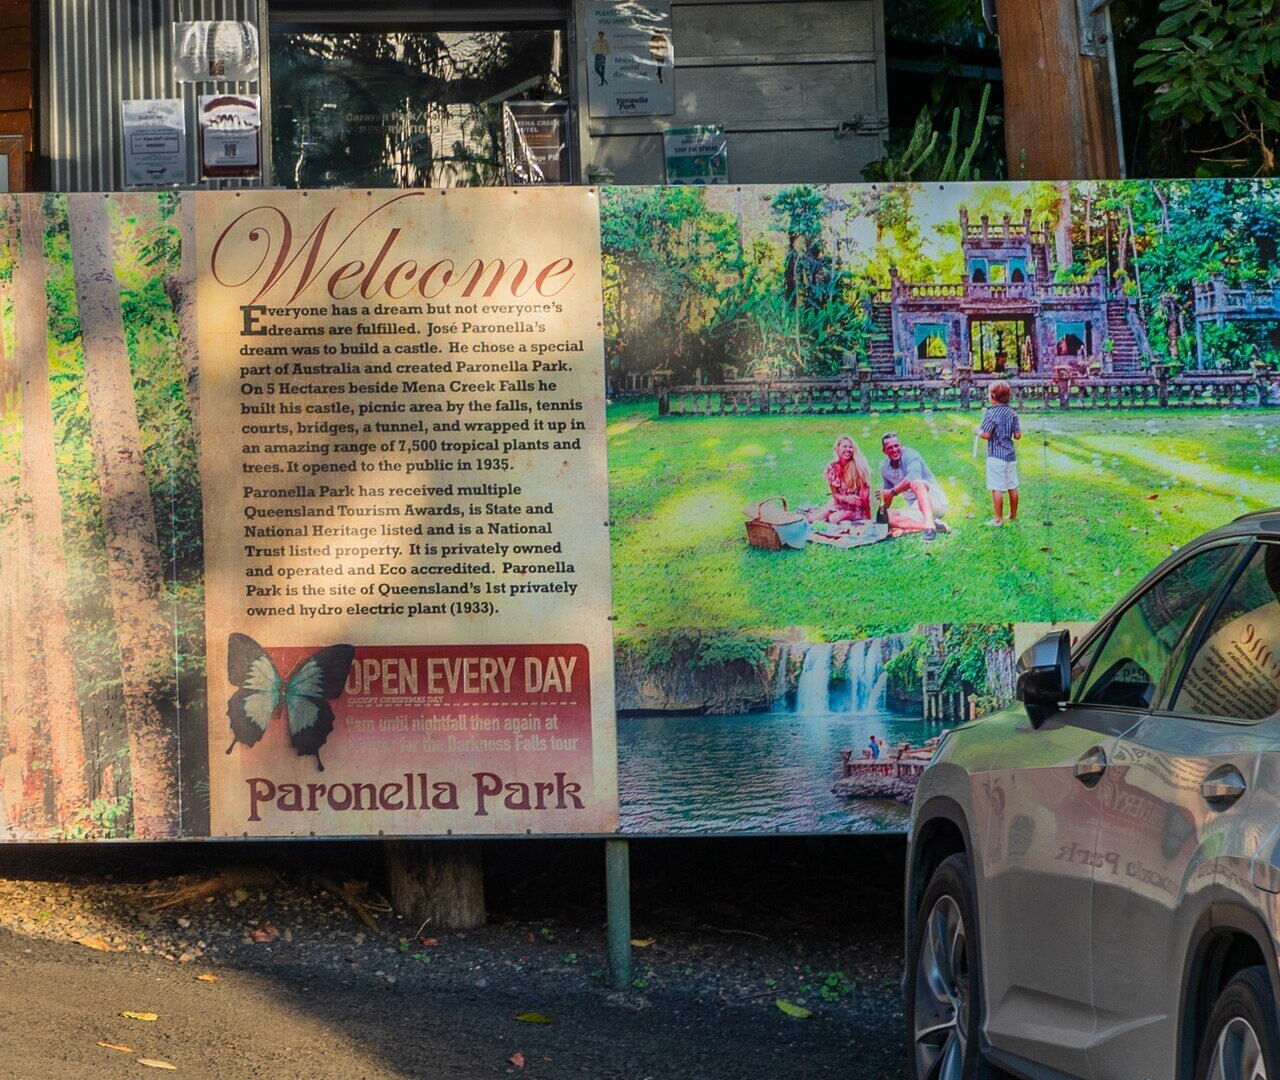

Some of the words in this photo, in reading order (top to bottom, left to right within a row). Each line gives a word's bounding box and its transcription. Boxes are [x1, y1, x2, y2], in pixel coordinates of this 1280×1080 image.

[345, 112, 389, 122] Caravn
[211, 191, 576, 307] Welcome
[240, 302, 328, 336] Everyone
[331, 304, 358, 316] has
[362, 307, 370, 315] a
[374, 303, 423, 315] dream
[426, 303, 450, 314] but
[455, 304, 477, 313] not
[482, 302, 562, 316] everyone's
[266, 324, 325, 336] dreams
[329, 327, 352, 335] are
[356, 323, 420, 335] fulfilled.
[427, 322, 458, 335] José
[462, 322, 545, 333] Paronella's
[240, 344, 288, 356] dream
[291, 346, 320, 355] was
[323, 344, 337, 355] to
[340, 342, 379, 354] build
[382, 345, 392, 354] a
[395, 342, 442, 354] castle.
[448, 342, 468, 353] He
[473, 341, 514, 352] chose
[531, 340, 584, 355] special
[240, 365, 271, 378] part
[274, 363, 290, 375] of
[292, 362, 361, 375] Australia
[364, 362, 392, 374] and
[396, 362, 452, 373] created
[456, 361, 528, 372] Paronella
[532, 360, 572, 372] Park.
[241, 383, 264, 395] On
[267, 383, 275, 394] 5
[278, 382, 345, 394] Hectares
[348, 381, 398, 393] beside
[402, 381, 446, 393] Mena
[450, 380, 495, 392] Creek
[499, 380, 534, 392] Falls
[538, 379, 556, 391] he
[240, 402, 276, 414] built
[279, 402, 302, 414] his
[306, 401, 354, 416] castle,
[358, 401, 405, 416] picnic
[410, 403, 443, 412] area
[446, 400, 464, 415] by
[468, 400, 491, 412] the
[496, 399, 532, 414] falls,
[536, 399, 582, 411] tennis
[242, 423, 292, 436] courts,
[297, 421, 358, 436] bridges,
[363, 424, 372, 432] a
[376, 420, 428, 435] tunnel,
[433, 420, 461, 432] and
[464, 419, 530, 435] wrapped
[534, 419, 544, 430] it
[547, 422, 566, 433] up
[571, 419, 586, 430] in
[345, 658, 418, 695] OPEN
[427, 657, 517, 695] EVERY
[524, 656, 578, 694] DAY
[346, 697, 378, 705] EXCEPT
[379, 696, 427, 704] CHRISTMAS
[379, 715, 410, 731] until
[412, 714, 467, 734] nightfall
[469, 714, 501, 730] then
[503, 713, 541, 734] again
[544, 714, 558, 730] at
[422, 736, 444, 753] the
[447, 734, 511, 753] Darkness
[514, 733, 548, 752] Falls
[550, 735, 578, 752] tour
[245, 773, 459, 821] Paronella
[472, 772, 585, 816] Park
